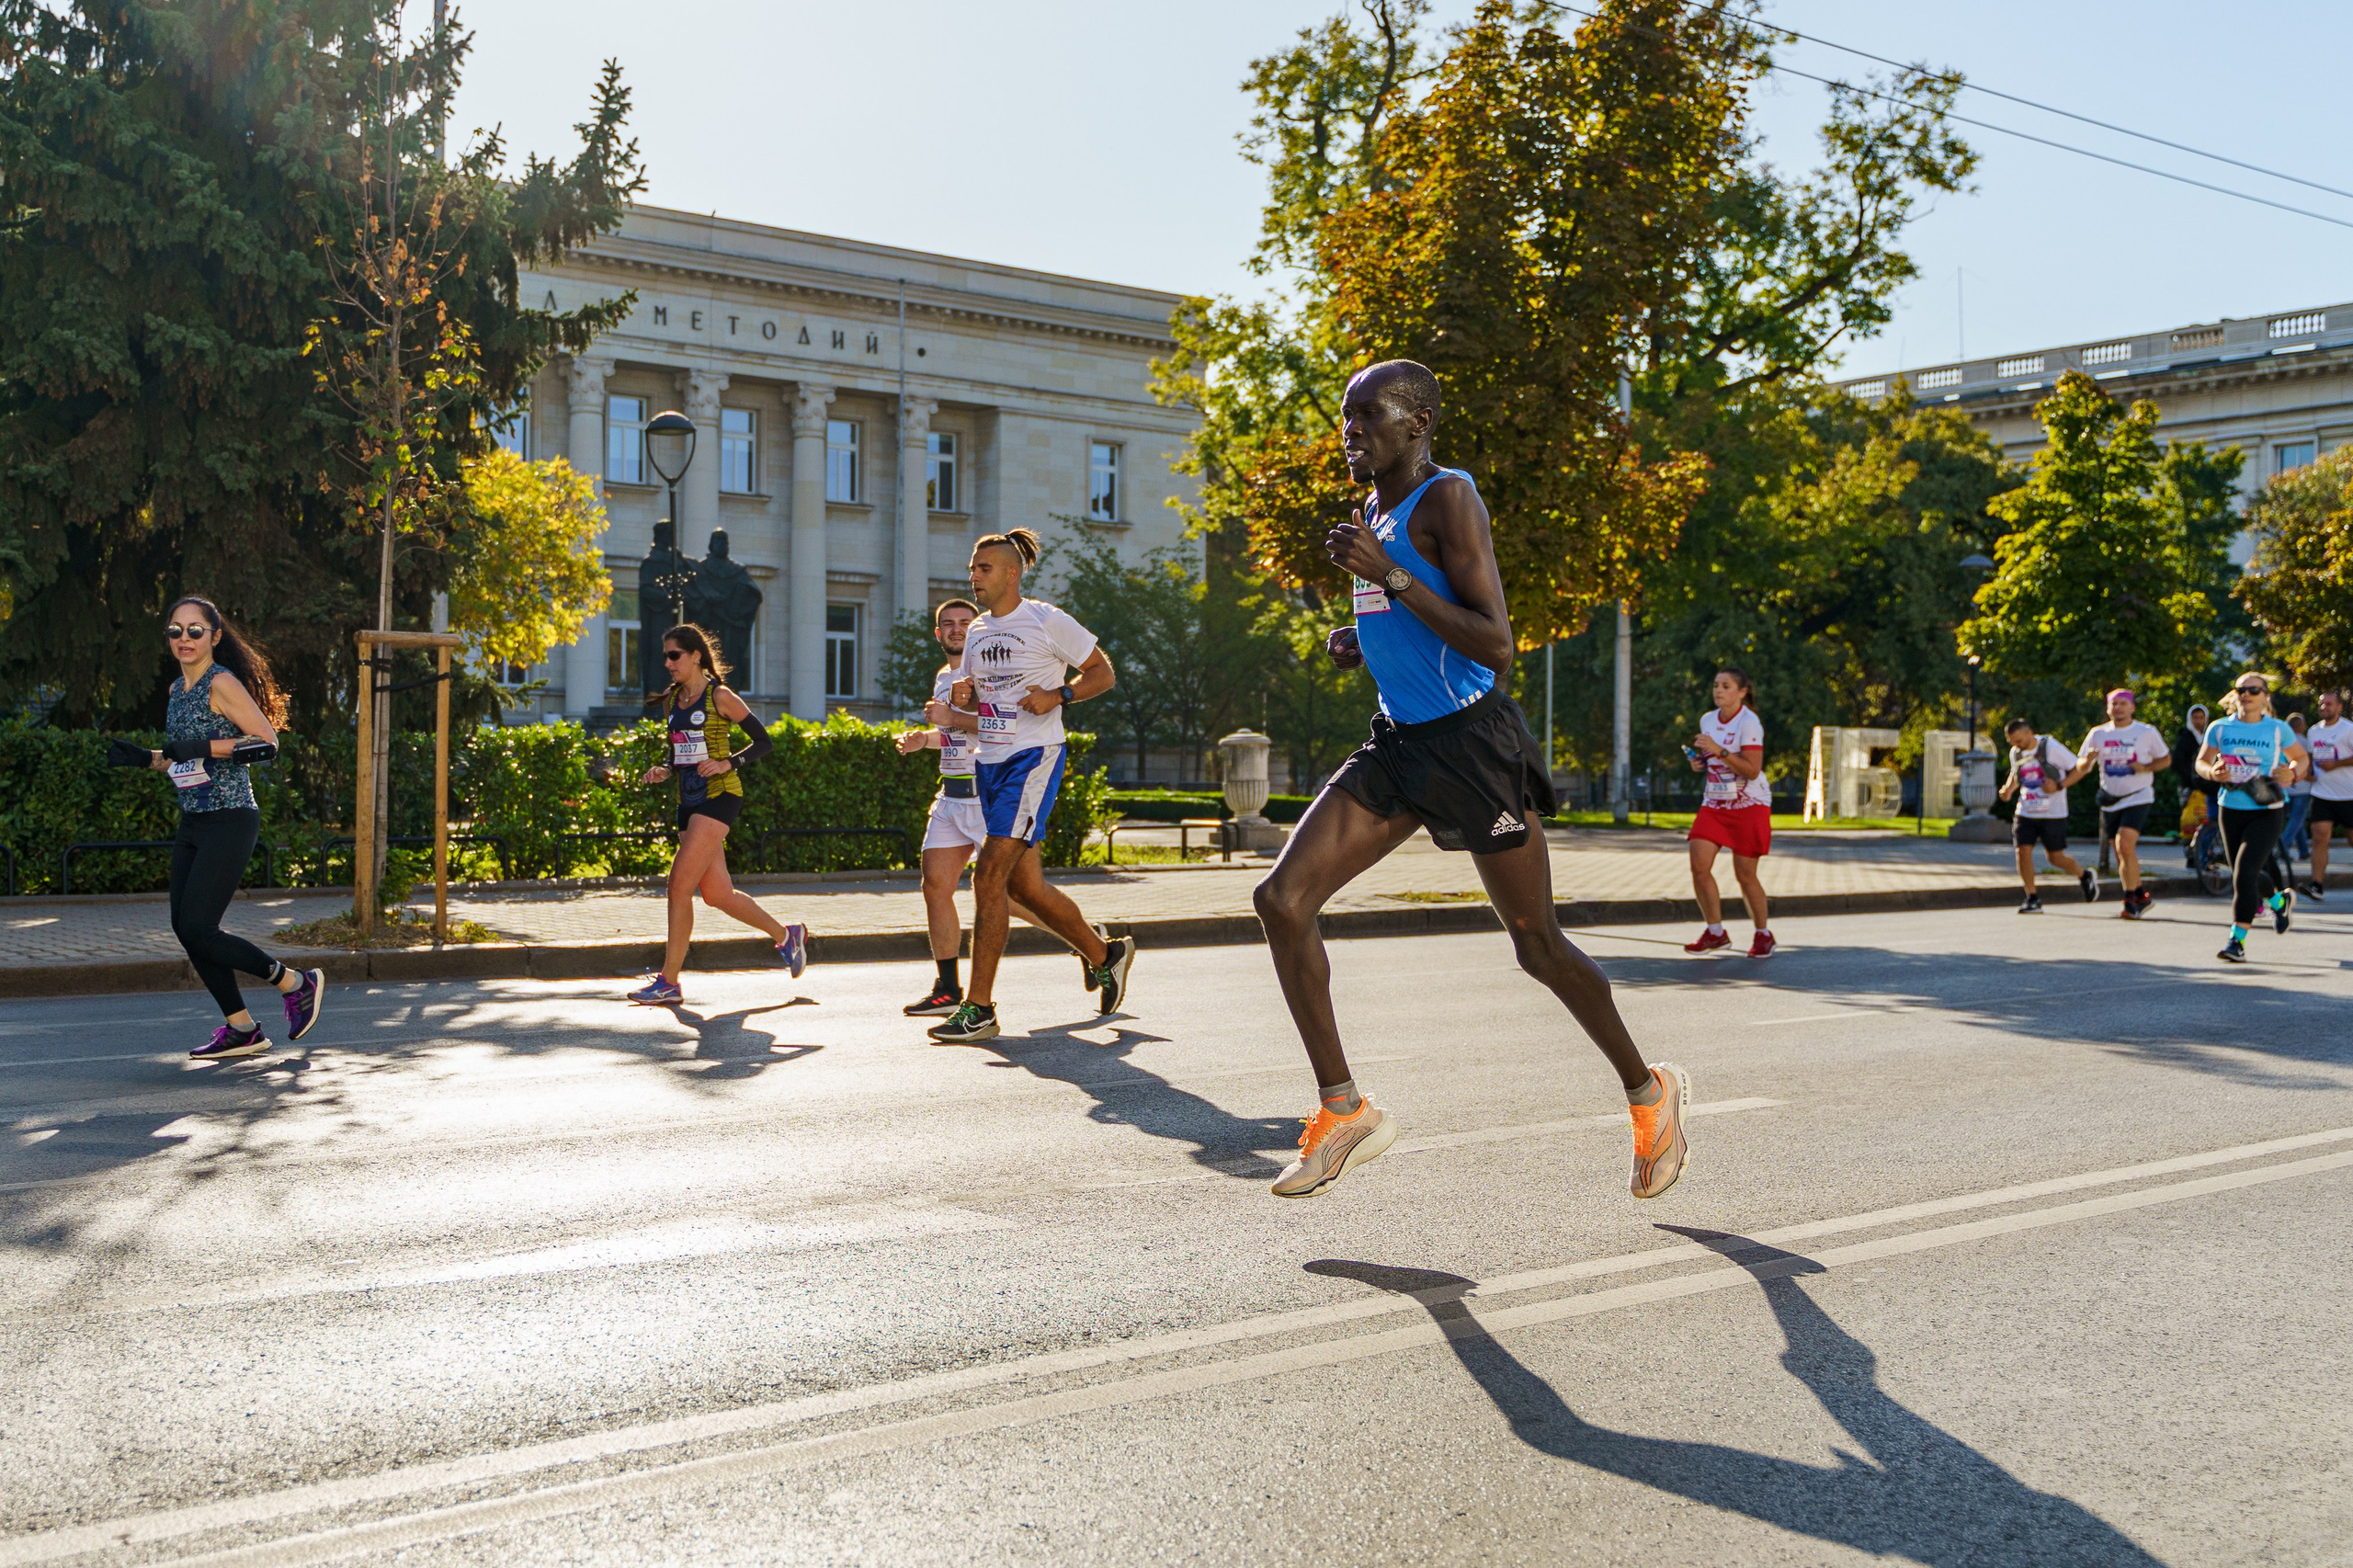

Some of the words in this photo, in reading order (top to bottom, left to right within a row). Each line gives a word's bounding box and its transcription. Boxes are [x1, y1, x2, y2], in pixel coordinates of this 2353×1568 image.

[654, 305, 879, 355] МЕТОДИЙ
[982, 718, 1006, 730] 2363
[679, 744, 698, 754] 2037
[2222, 738, 2269, 748] GARMIN
[174, 760, 196, 775] 2282
[1491, 823, 1526, 836] adidas
